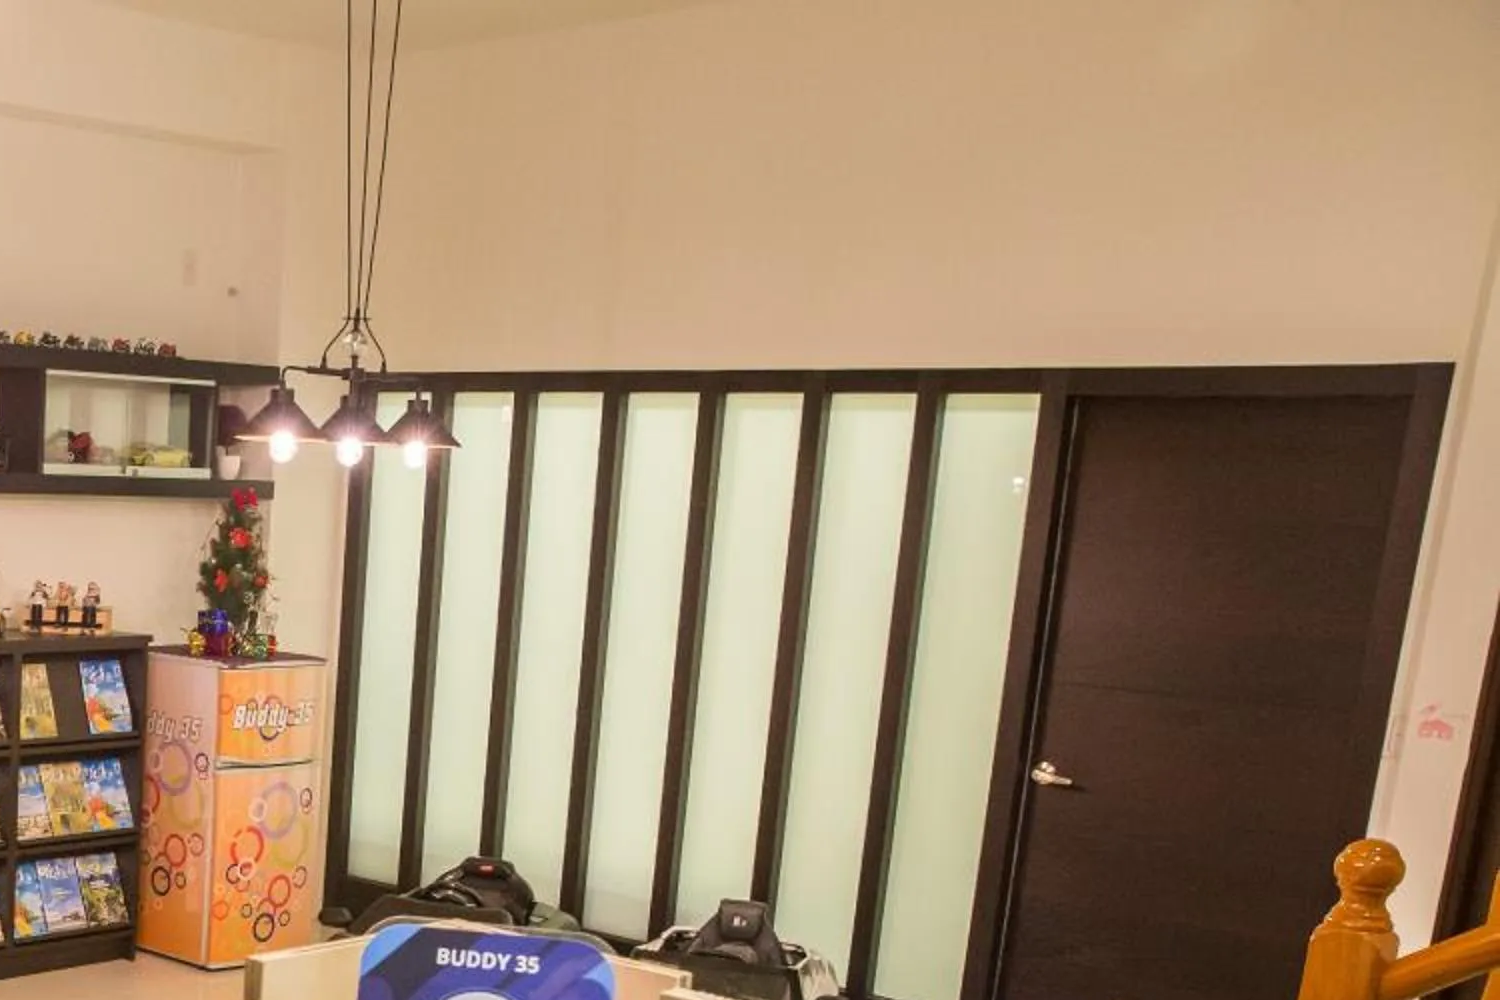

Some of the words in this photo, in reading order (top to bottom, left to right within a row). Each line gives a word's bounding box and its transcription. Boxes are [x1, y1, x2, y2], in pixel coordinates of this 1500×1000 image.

[148, 710, 176, 742] ddy
[181, 717, 201, 741] 35
[234, 702, 288, 732] Buddy
[436, 948, 509, 971] BUDDY
[515, 955, 540, 974] 35
